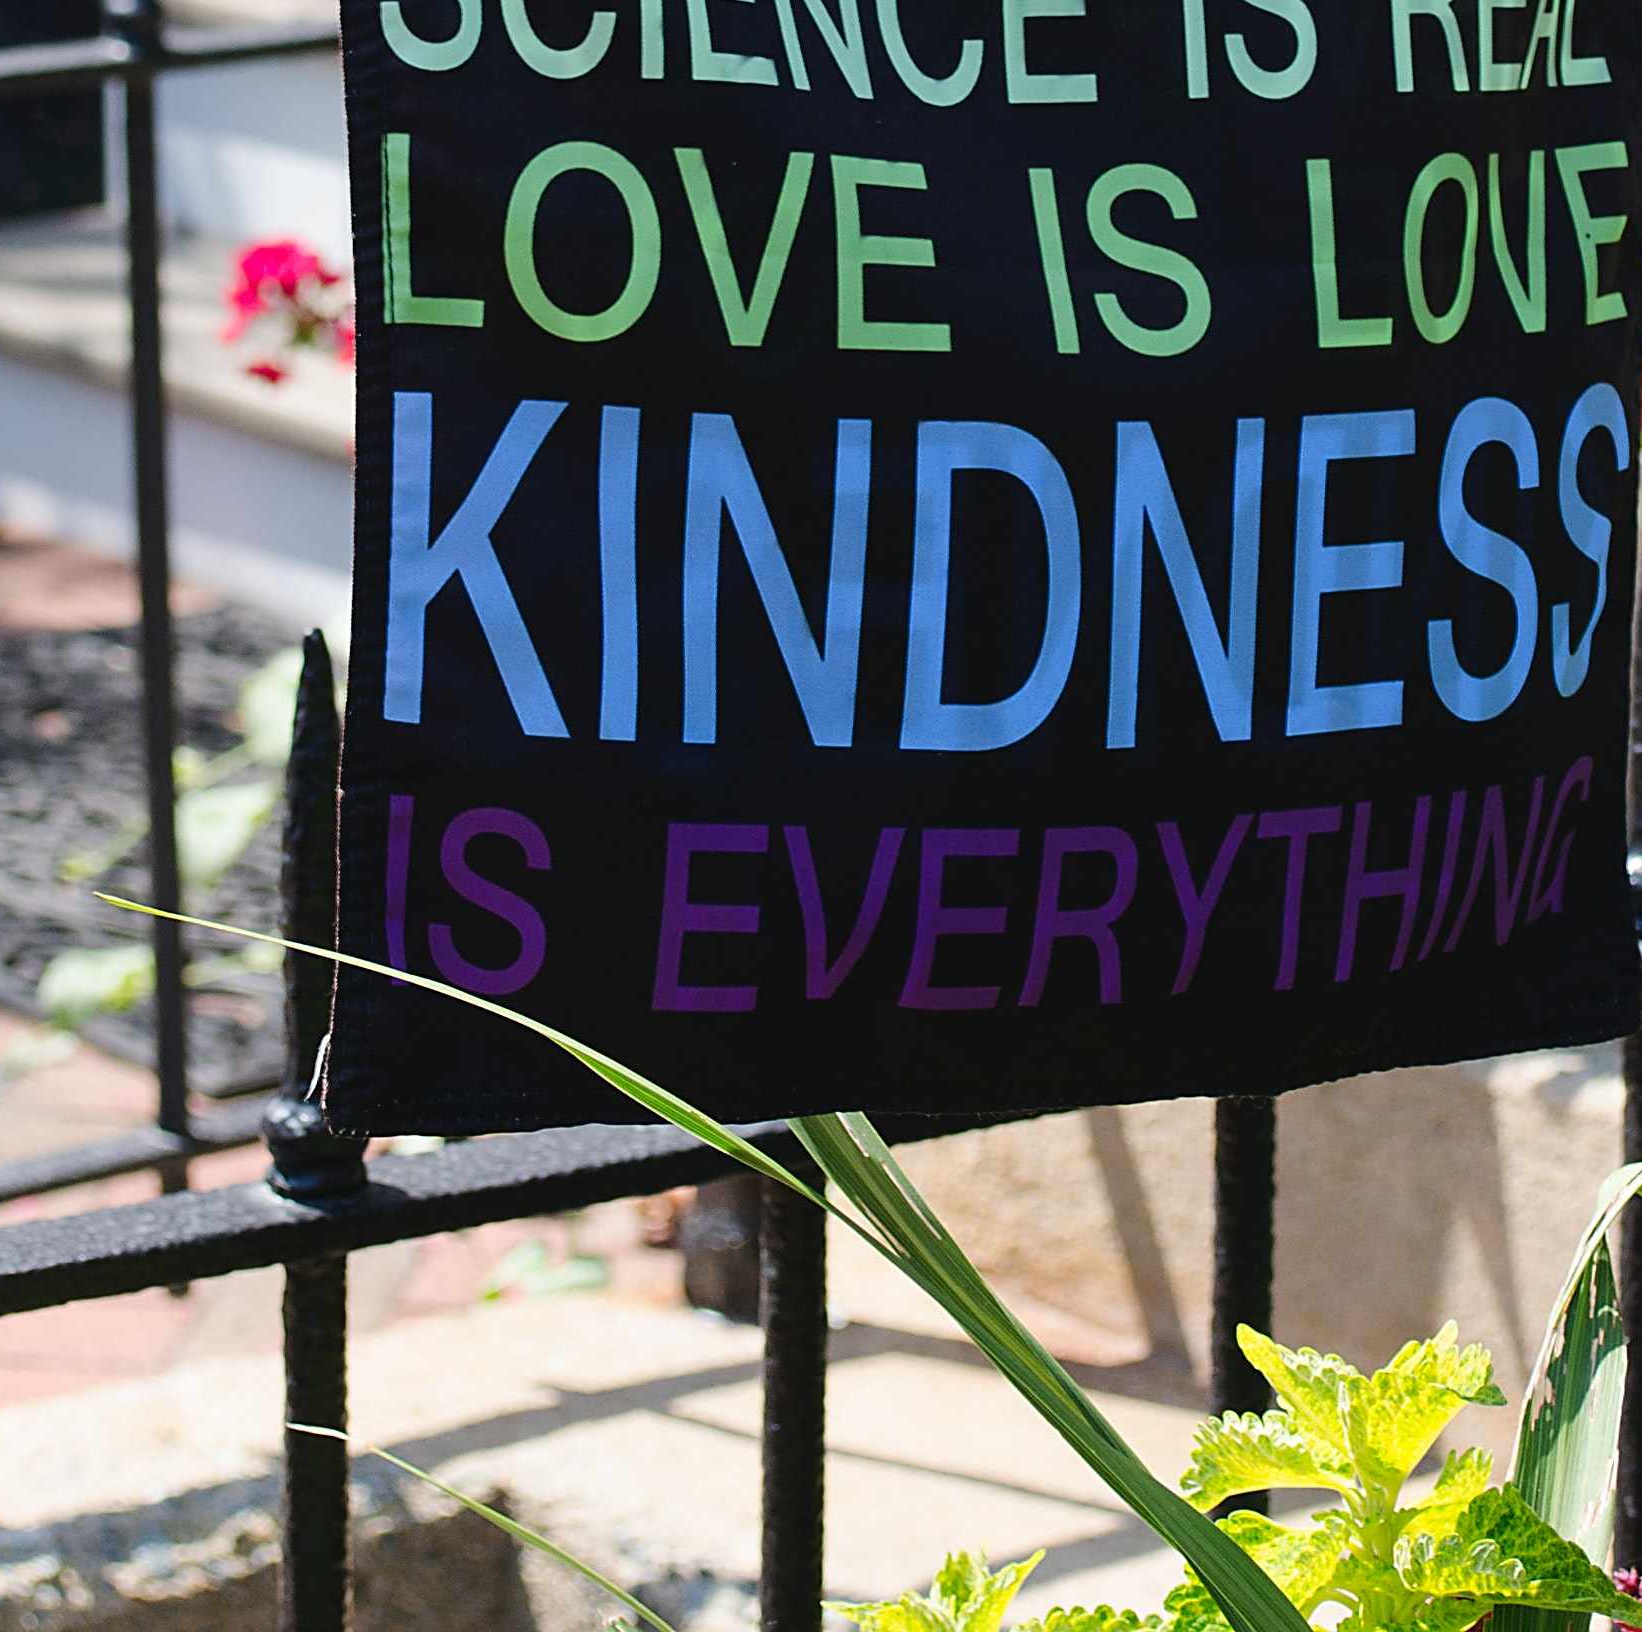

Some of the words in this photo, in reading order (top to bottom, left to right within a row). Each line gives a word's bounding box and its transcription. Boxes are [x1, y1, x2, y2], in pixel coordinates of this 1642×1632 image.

[381, 133, 951, 352] LOVE
[1029, 164, 1211, 356] IS
[1306, 141, 1628, 348] LOVE
[383, 381, 1632, 752] KINDNESS
[386, 795, 549, 993] IS
[651, 755, 1594, 1012] EVERYTHING
